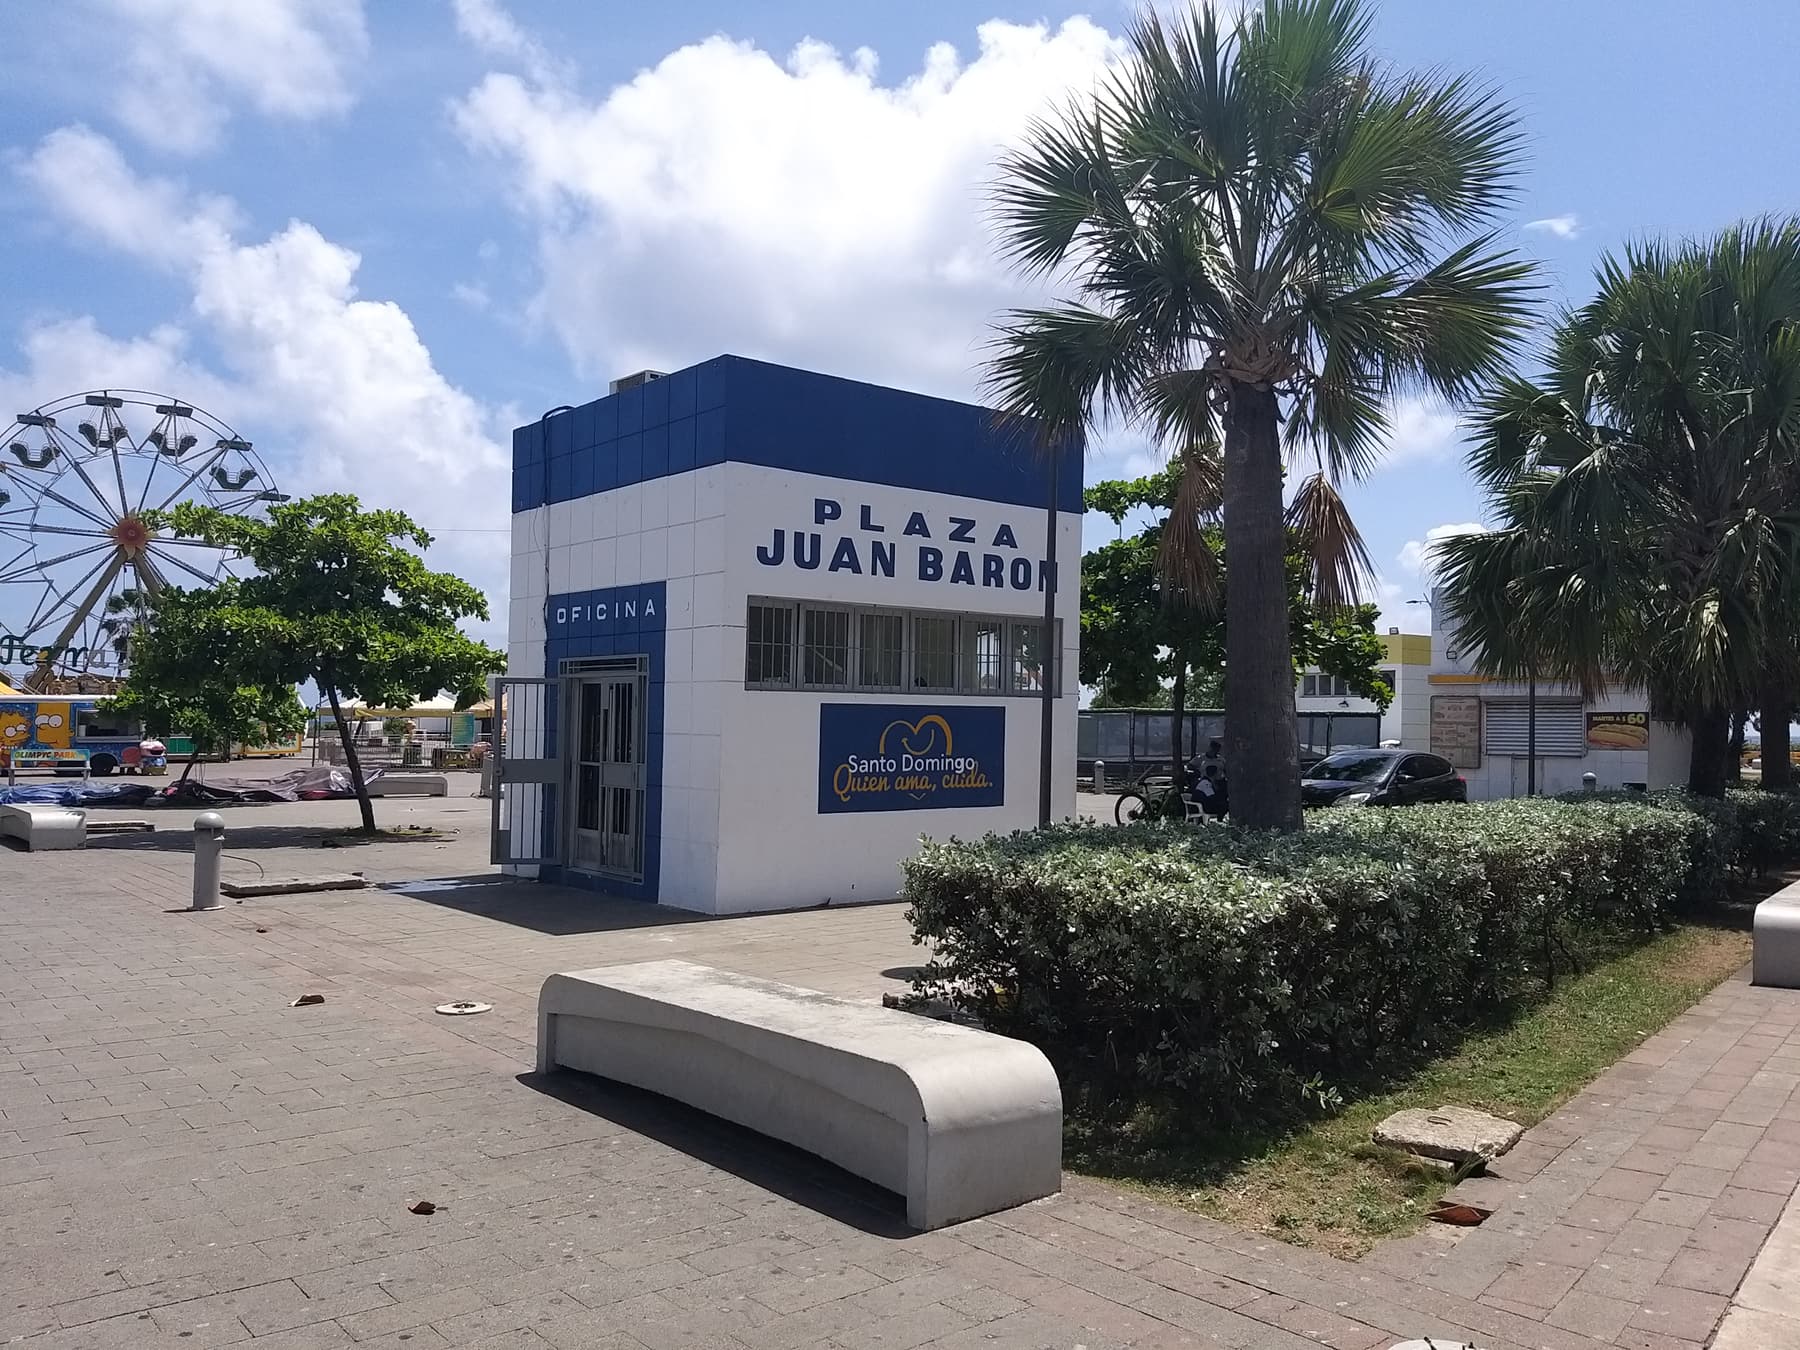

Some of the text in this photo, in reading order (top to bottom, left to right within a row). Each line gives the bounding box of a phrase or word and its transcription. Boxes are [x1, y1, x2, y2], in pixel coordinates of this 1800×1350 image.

[814, 498, 1018, 549] PLAZA
[756, 528, 1058, 593] JUAN BARON
[557, 599, 656, 624] OFICINA
[1627, 713, 1646, 724] 60
[848, 754, 975, 774] Santo Domingo
[833, 760, 993, 802] Quien ama, cuida.
